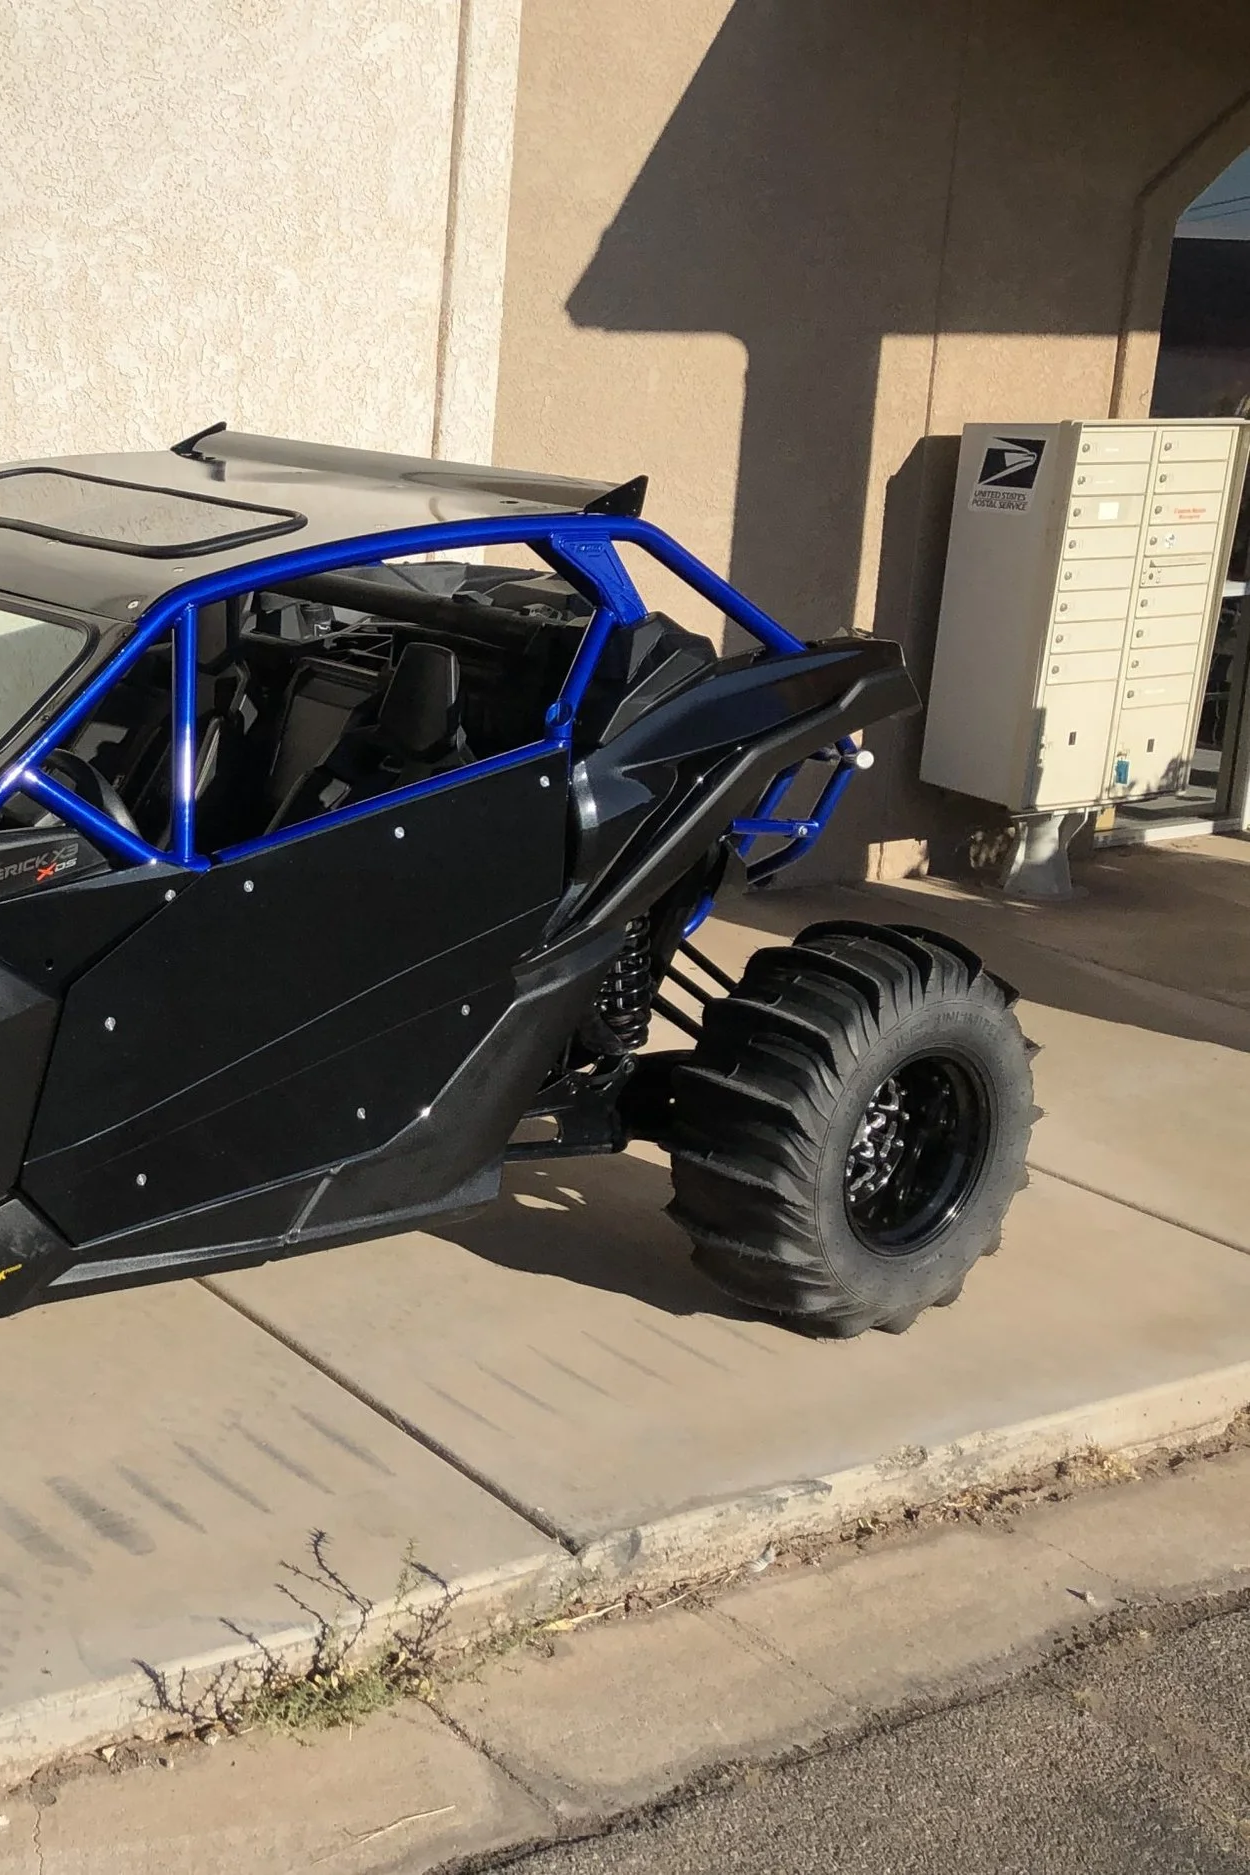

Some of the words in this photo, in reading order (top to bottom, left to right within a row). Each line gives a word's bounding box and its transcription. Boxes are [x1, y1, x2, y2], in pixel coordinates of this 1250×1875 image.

[974, 490, 1001, 499] UNITED
[1001, 491, 1026, 501] STATES
[972, 499, 997, 509] POSTAL
[998, 501, 1029, 511] SERVICE
[52, 843, 79, 863] X3
